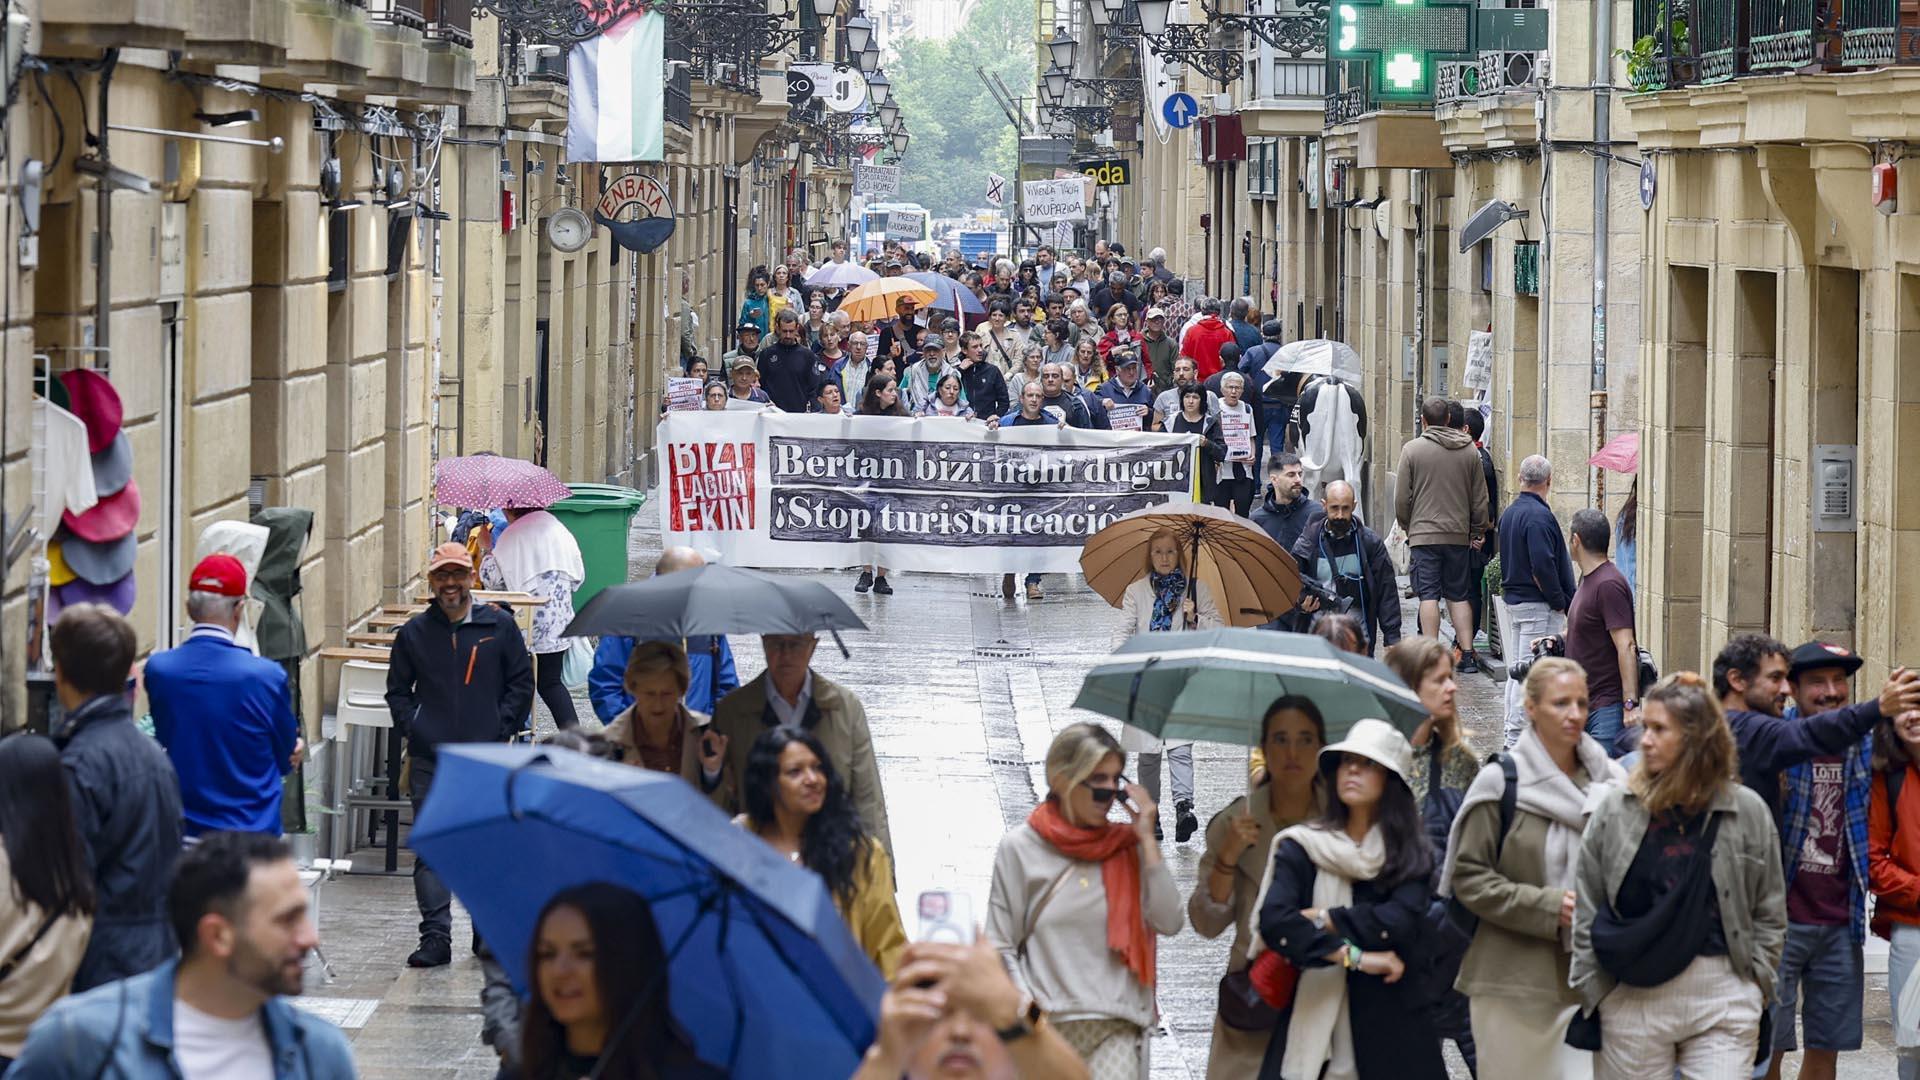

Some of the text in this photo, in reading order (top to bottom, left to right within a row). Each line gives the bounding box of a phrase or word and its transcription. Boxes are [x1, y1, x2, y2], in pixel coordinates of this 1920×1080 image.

[601, 178, 663, 218] ENBATA
[858, 180, 870, 190] GO
[673, 443, 744, 475] BIZI
[774, 443, 1185, 491] Bertan bizi nahi dugu!
[677, 470, 748, 503] LAGUN
[680, 499, 751, 531] EKIN
[775, 495, 872, 539] ¡Stop
